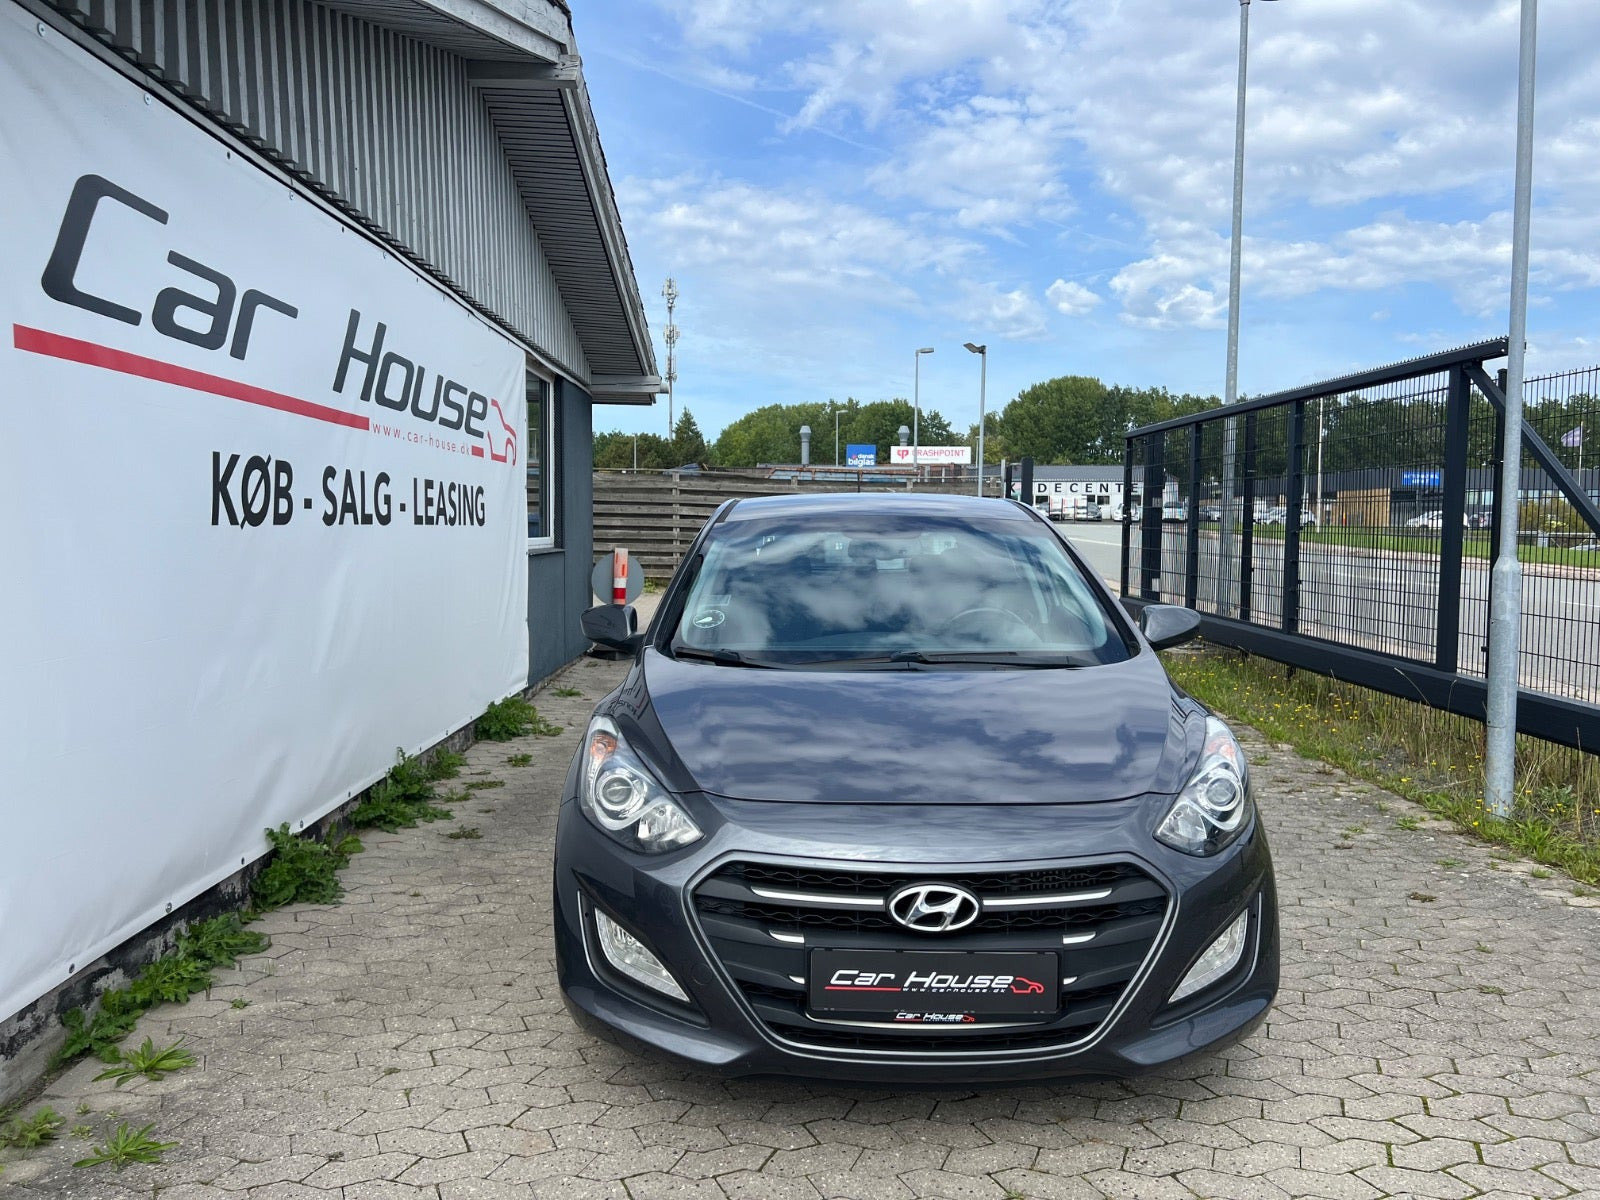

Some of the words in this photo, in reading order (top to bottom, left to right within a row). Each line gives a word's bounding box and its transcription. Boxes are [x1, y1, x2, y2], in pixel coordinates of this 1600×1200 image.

[41, 174, 298, 361] Car
[332, 308, 488, 439] House
[372, 423, 470, 456] www.car-house.dk
[848, 458, 875, 467] bilglas
[211, 450, 294, 529] KØB
[322, 465, 392, 527] SALG
[413, 477, 486, 527] LEASING
[830, 969, 896, 986] Car
[903, 971, 1014, 988] House
[923, 1012, 964, 1020] House
